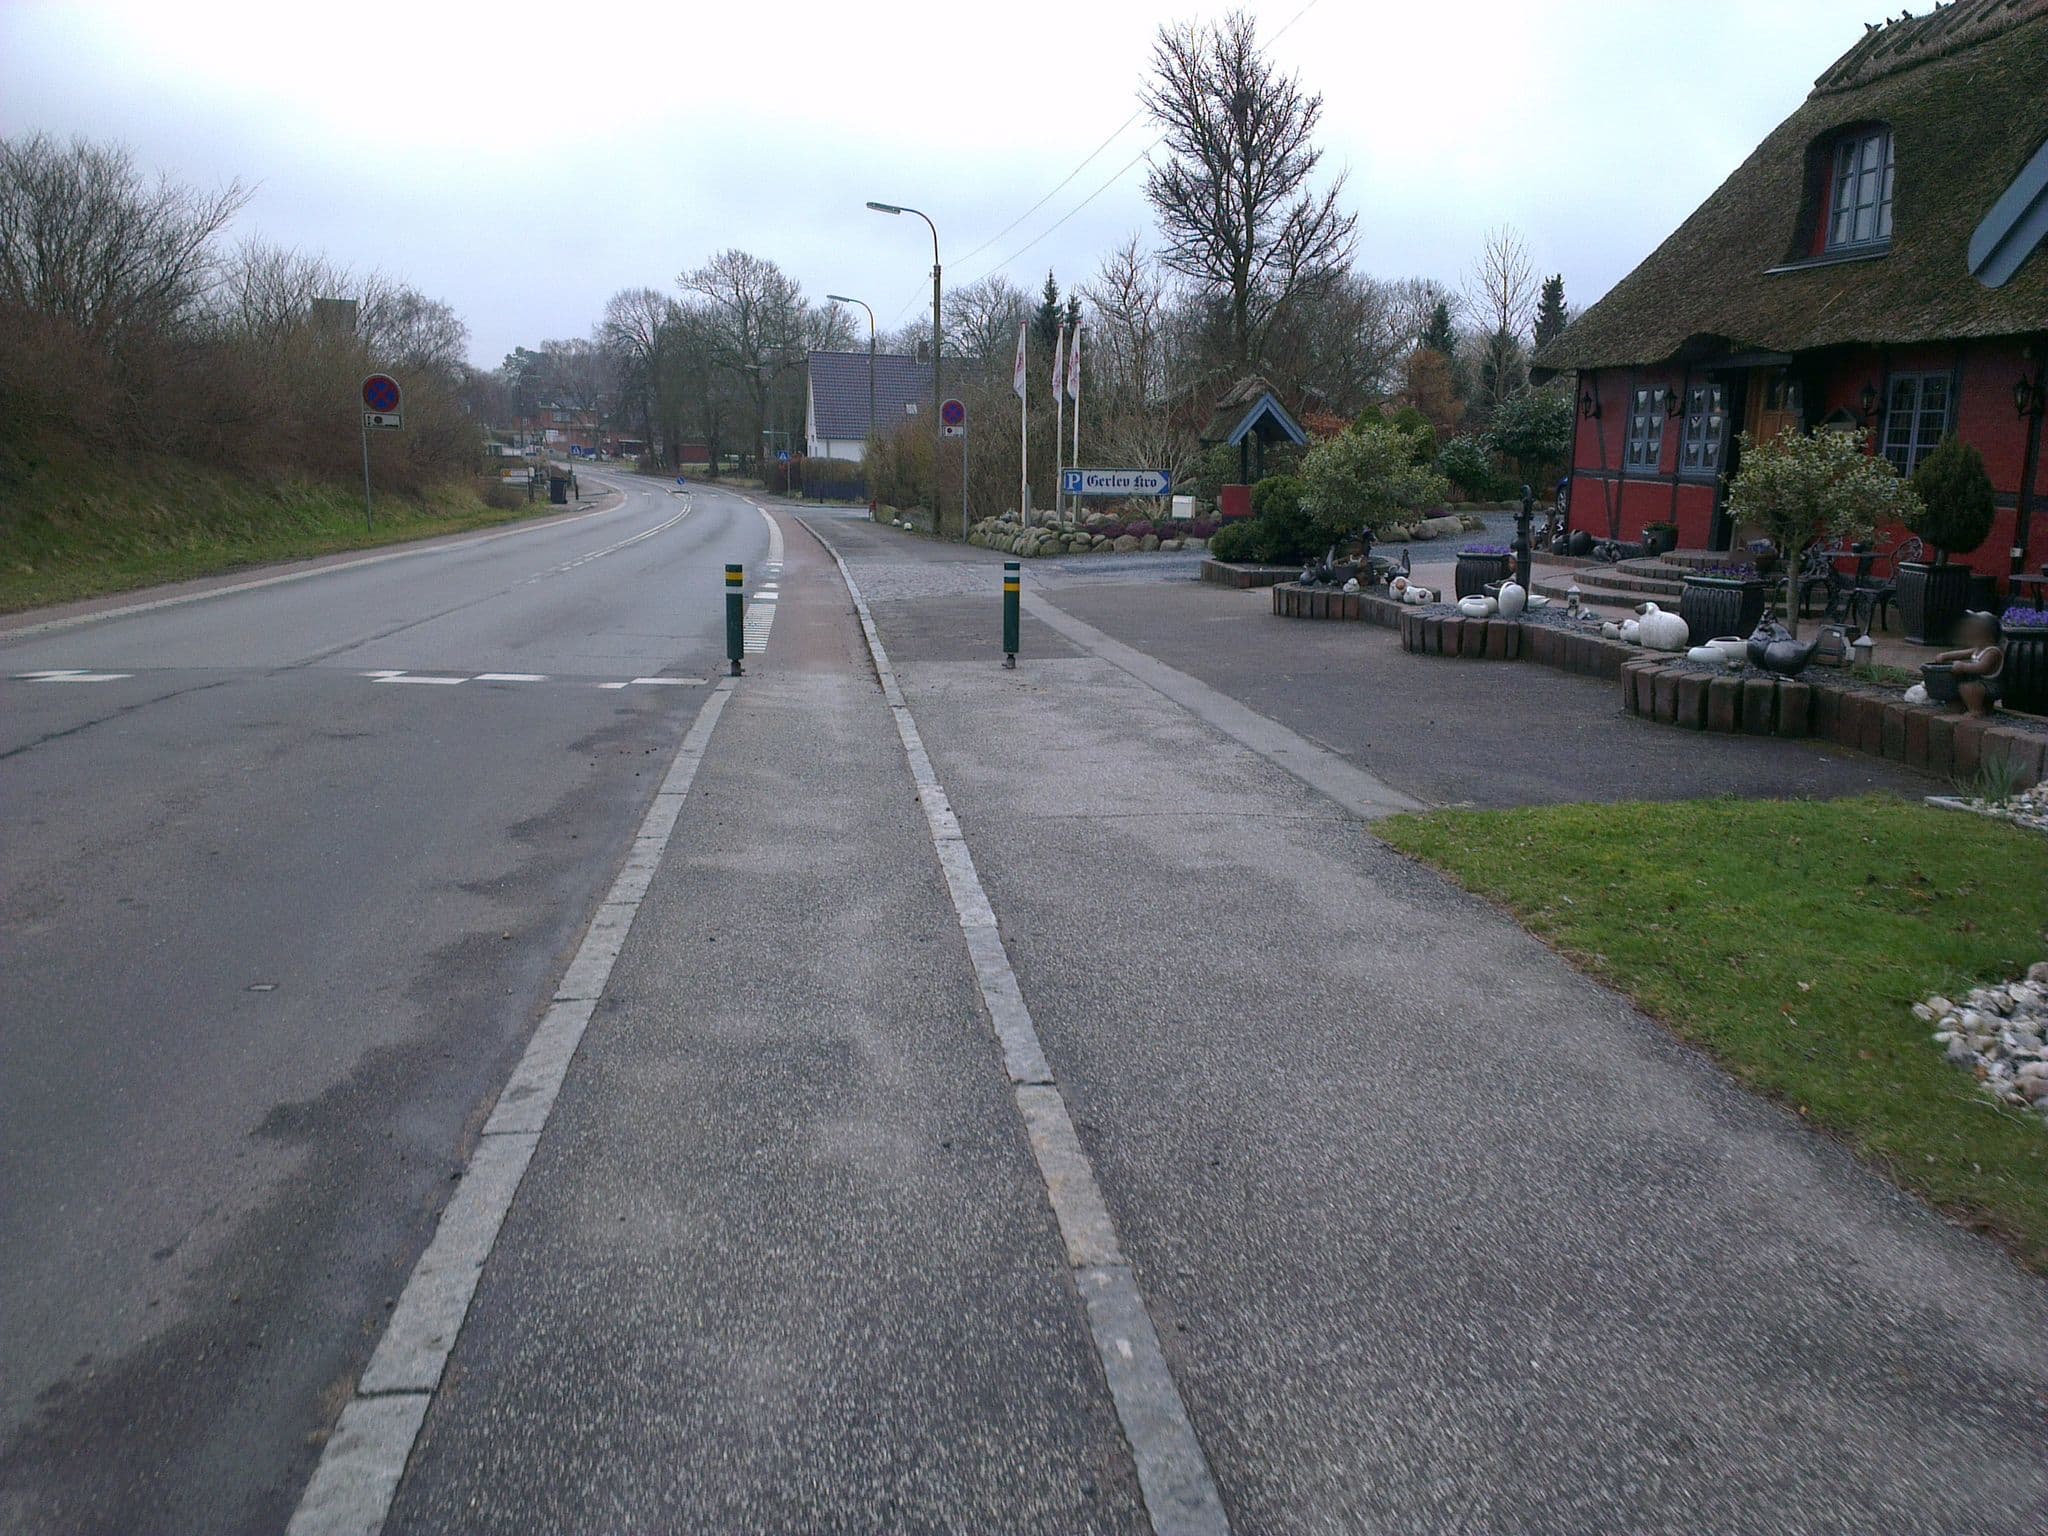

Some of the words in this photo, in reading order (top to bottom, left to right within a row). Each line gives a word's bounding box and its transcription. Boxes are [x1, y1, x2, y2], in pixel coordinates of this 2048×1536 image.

[1066, 473, 1081, 490] P
[1087, 474, 1130, 487] Gerlev
[1133, 474, 1157, 488] Kro
